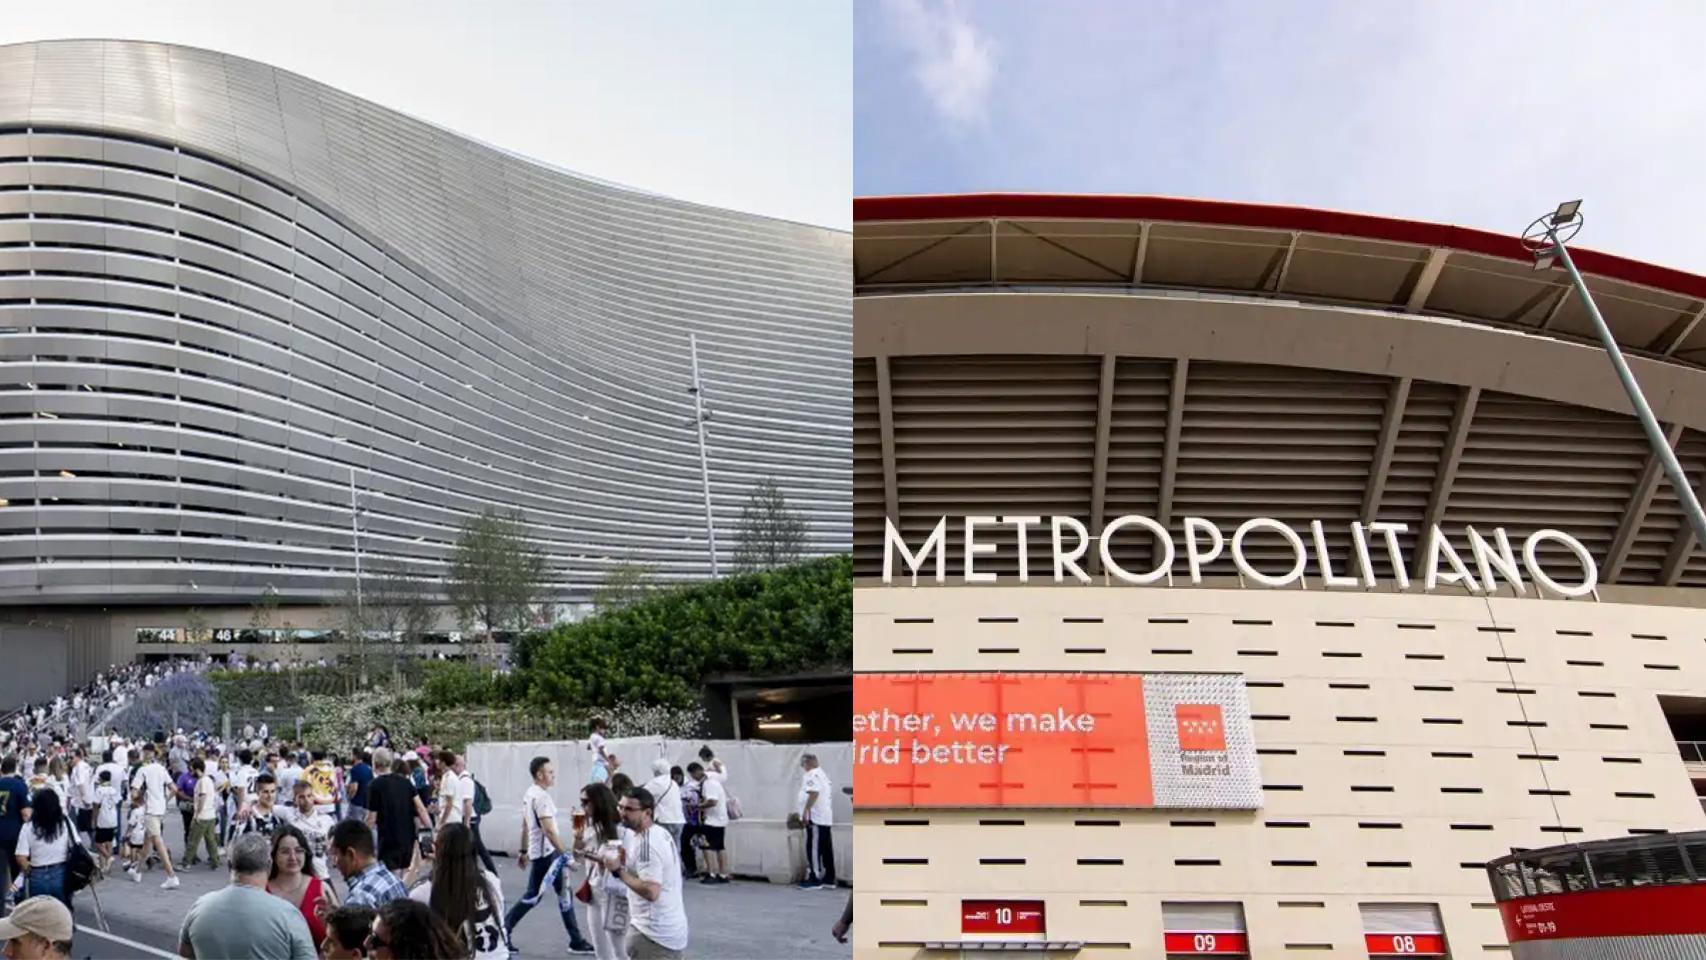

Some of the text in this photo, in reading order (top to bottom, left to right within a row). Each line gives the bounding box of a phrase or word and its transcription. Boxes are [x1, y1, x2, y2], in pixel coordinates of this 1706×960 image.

[882, 514, 1598, 596] METROPOLITANO
[950, 713, 997, 731] we
[1007, 707, 1096, 732] make
[853, 738, 1010, 764] rid better
[1182, 764, 1230, 776] Madrid
[994, 907, 1012, 925] 10
[1194, 934, 1215, 951] 09
[1393, 935, 1416, 952] 08
